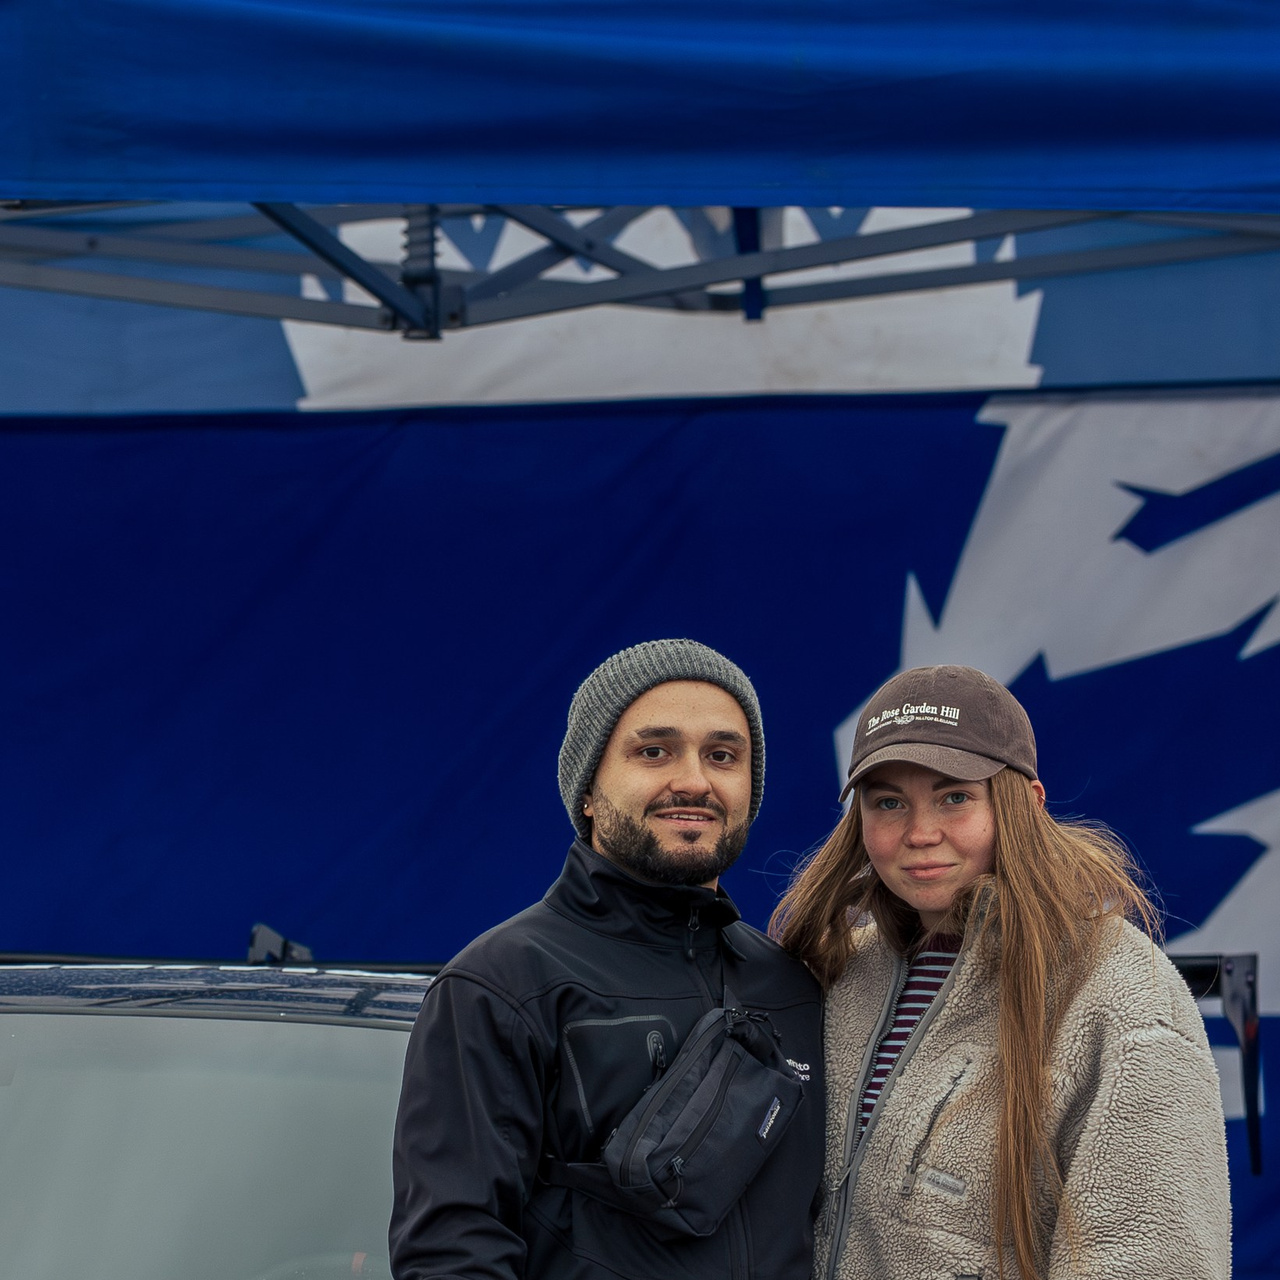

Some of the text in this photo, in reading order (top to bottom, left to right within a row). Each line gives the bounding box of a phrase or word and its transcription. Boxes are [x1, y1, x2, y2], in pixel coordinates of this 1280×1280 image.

[868, 716, 880, 730] The
[881, 708, 900, 722] Rose
[902, 702, 938, 715] Garden
[940, 705, 960, 720] Hill
